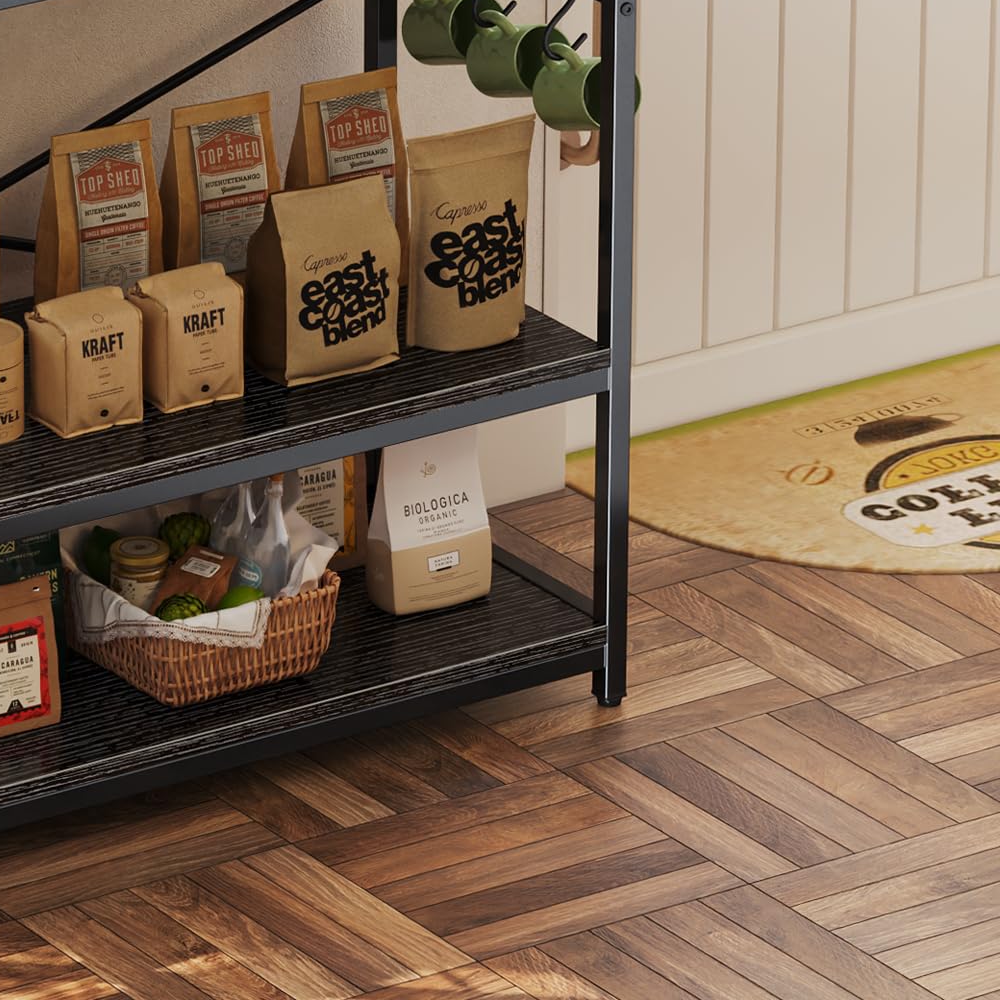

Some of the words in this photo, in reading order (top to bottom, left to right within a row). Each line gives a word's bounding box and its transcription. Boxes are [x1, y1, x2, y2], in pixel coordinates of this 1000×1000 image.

[330, 122, 352, 143] TOP
[355, 115, 387, 136] SHED
[200, 147, 224, 167] TOP
[226, 140, 260, 161] SHED
[333, 147, 389, 164] HUEHUETENANGO
[79, 174, 104, 196] TOP
[107, 168, 141, 189] SHED
[205, 173, 261, 189] HUEHUETENANGO
[84, 201, 142, 217] HUEHUETENANGO
[431, 199, 488, 226] Capresso
[430, 198, 516, 258] east
[302, 252, 348, 273] Capresso
[300, 249, 376, 306] east
[298, 266, 390, 331] coast
[183, 307, 226, 335] KRAFT
[322, 302, 387, 347] blend
[81, 332, 125, 359] KRAFT
[300, 468, 337, 487] ARAGUA
[403, 491, 470, 517] BIOLOGICA
[418, 508, 458, 525] ORGANIC
